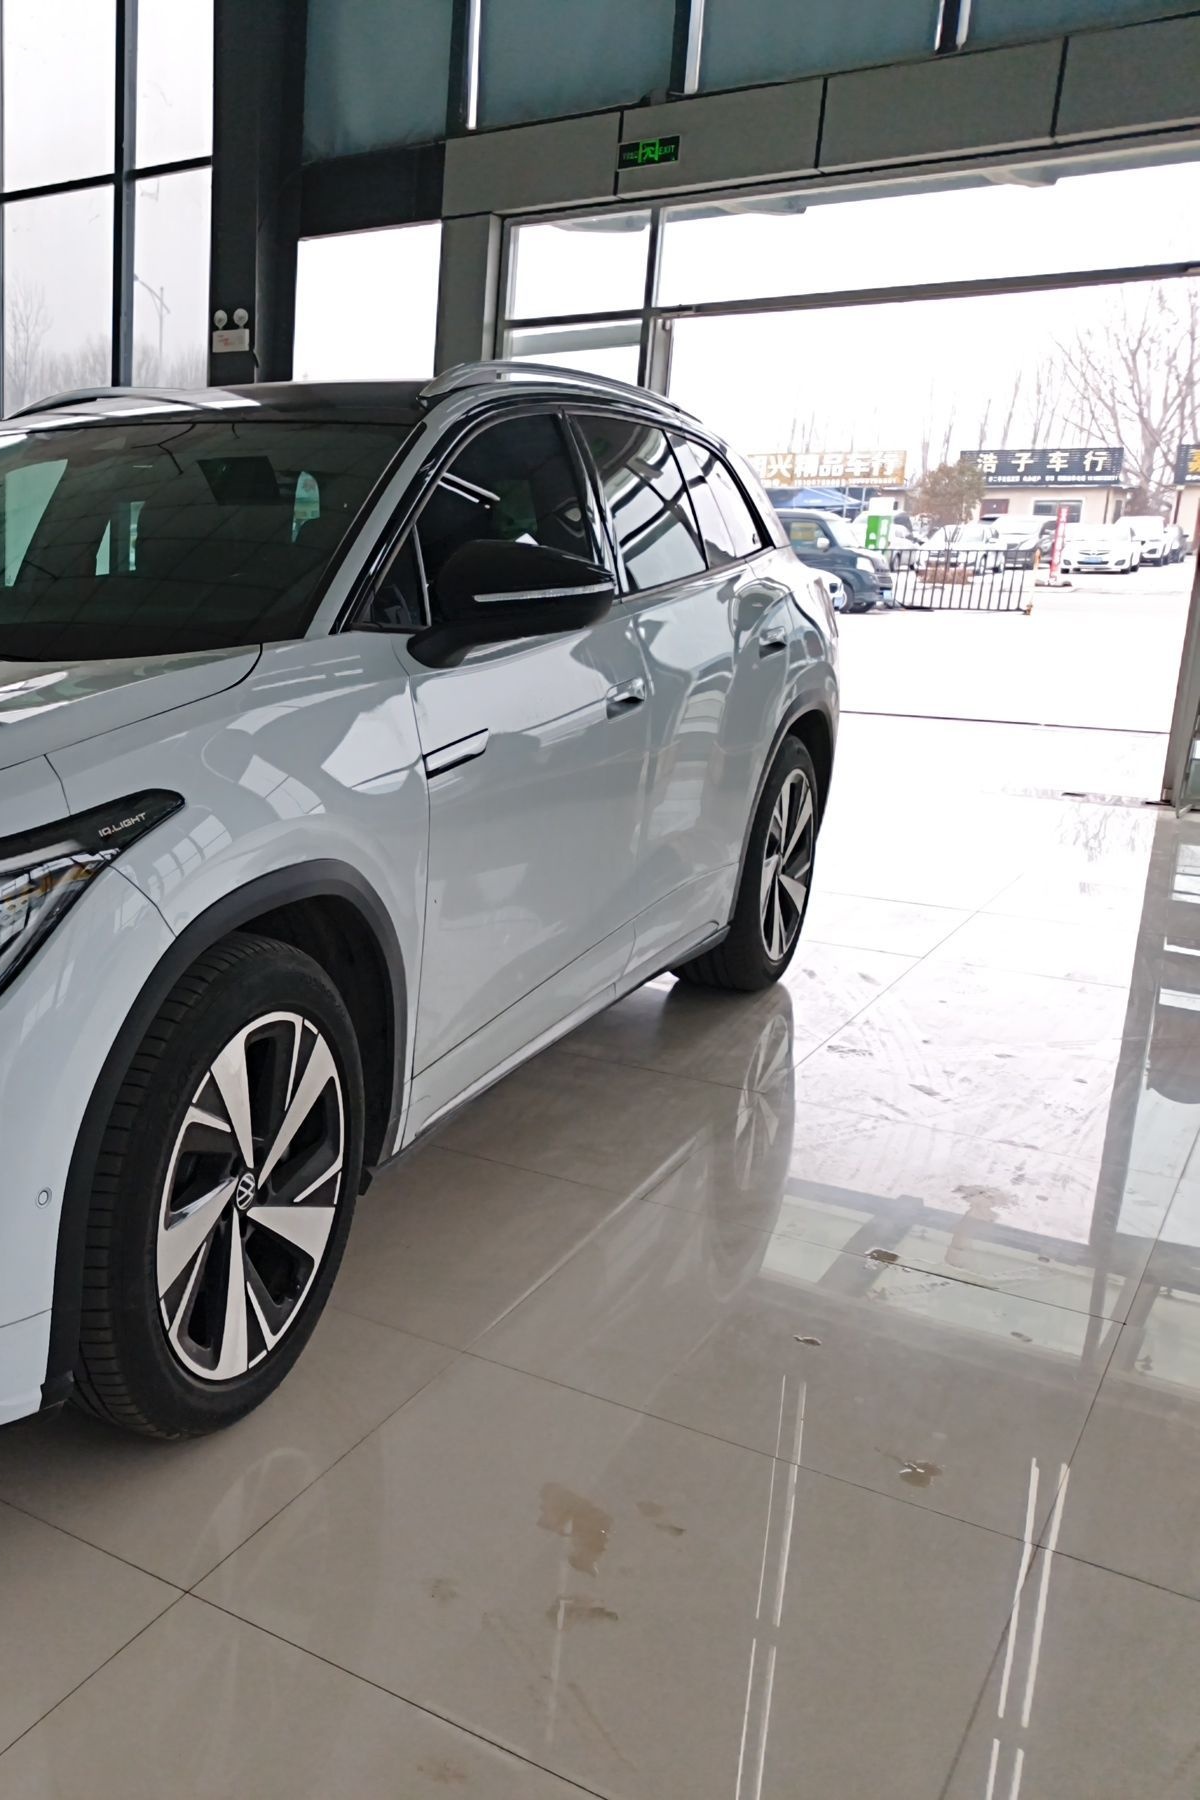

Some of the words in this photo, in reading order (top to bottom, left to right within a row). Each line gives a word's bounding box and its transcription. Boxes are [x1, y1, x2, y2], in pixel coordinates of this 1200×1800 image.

[977, 450, 1110, 473] 浩子车行
[98, 812, 147, 837] IQ.LIGHT
